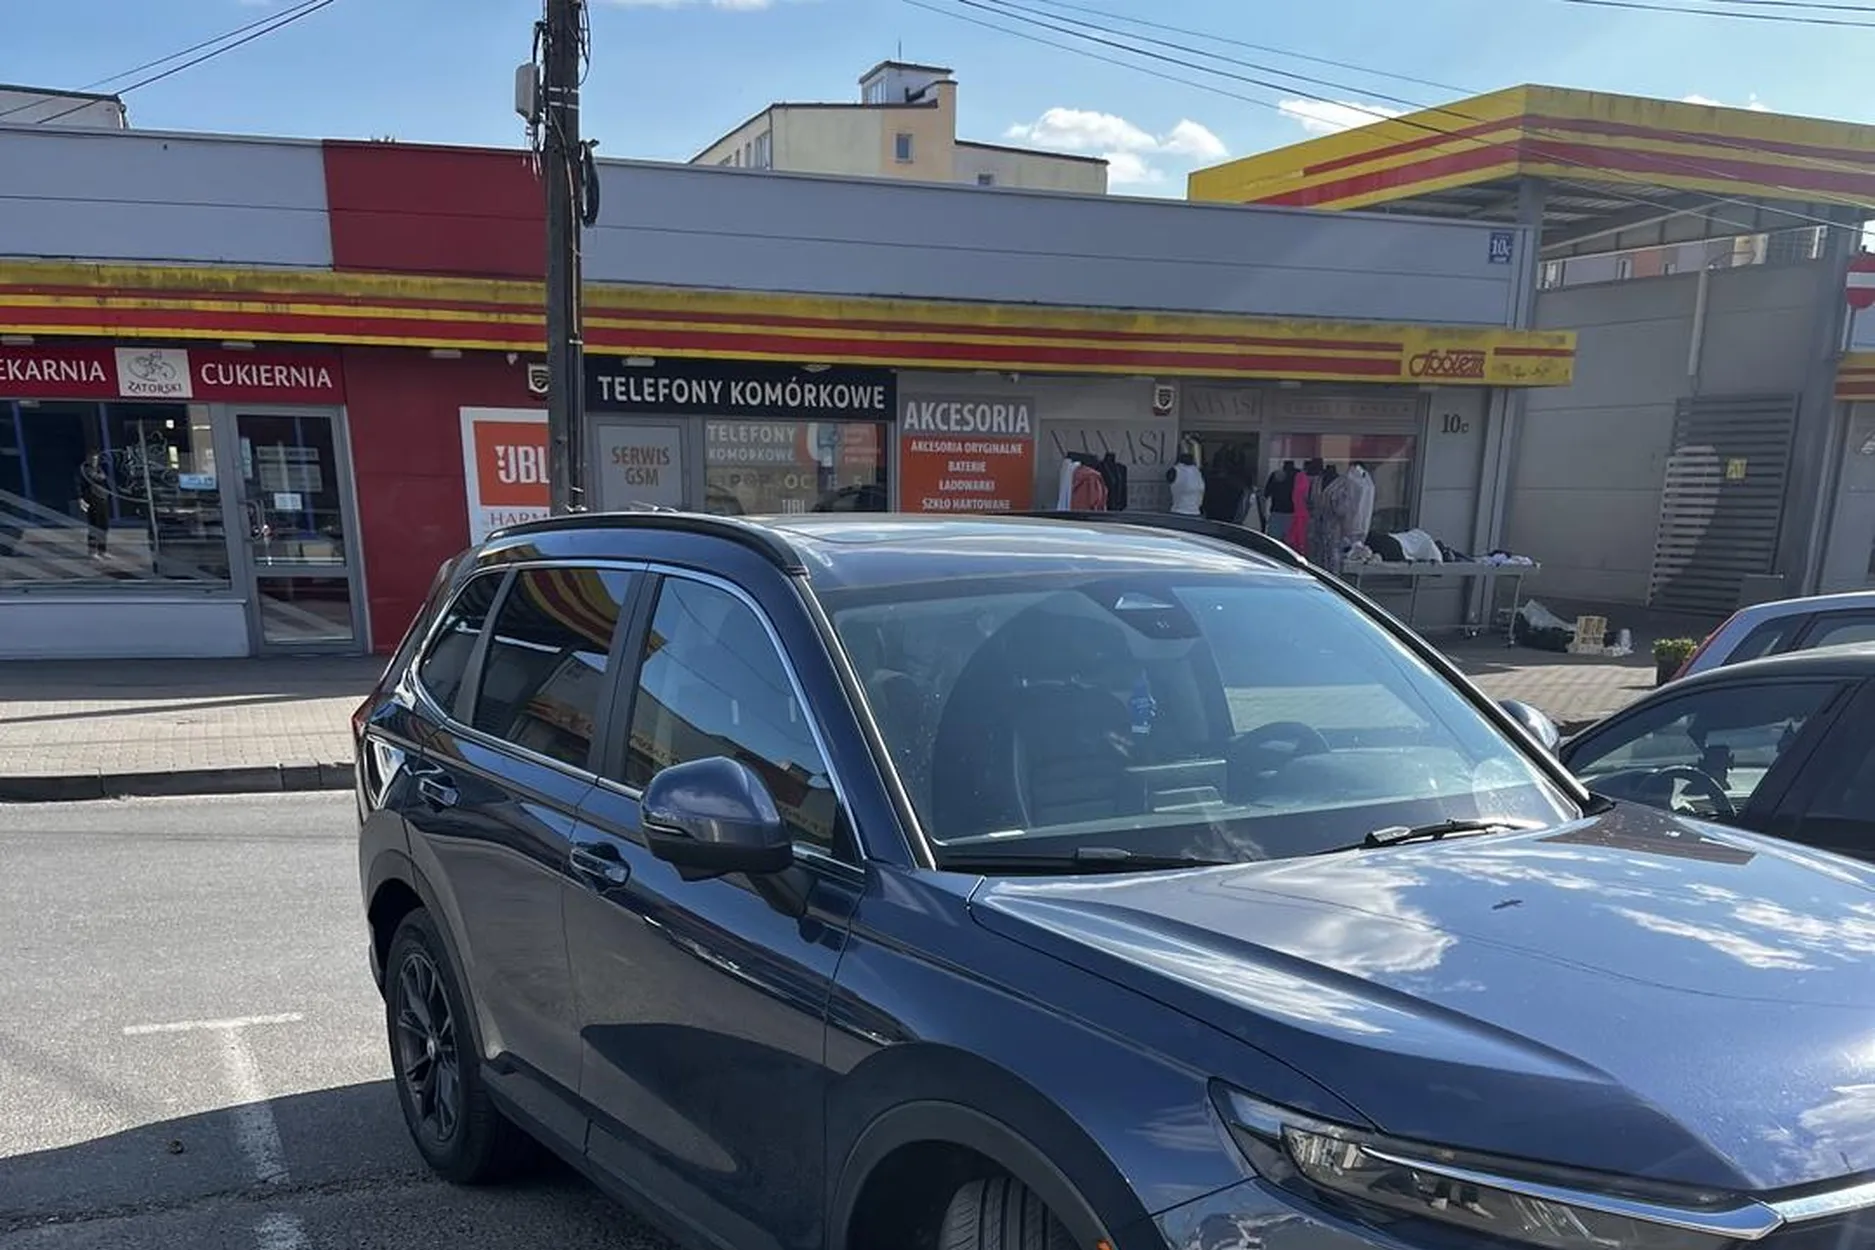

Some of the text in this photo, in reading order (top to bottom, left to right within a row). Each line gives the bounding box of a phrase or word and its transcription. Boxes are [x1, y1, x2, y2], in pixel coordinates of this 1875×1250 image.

[201, 363, 333, 388] CUKIERNIA
[127, 380, 183, 394] ZATORSKI
[597, 375, 885, 410] TELEFONY KOMÓRKOWE
[903, 401, 1031, 434] AKCESORIA
[1441, 413, 1469, 434] 10c
[707, 424, 796, 443] TELEFONY
[611, 446, 671, 465] SERWIS
[911, 440, 1024, 455] AKCESORIA ORYGINALNE
[948, 460, 986, 473] BATERIE
[624, 467, 660, 487] GSM
[938, 479, 996, 491] ŁADOWARKI
[952, 498, 1011, 511] HARTOWANE
